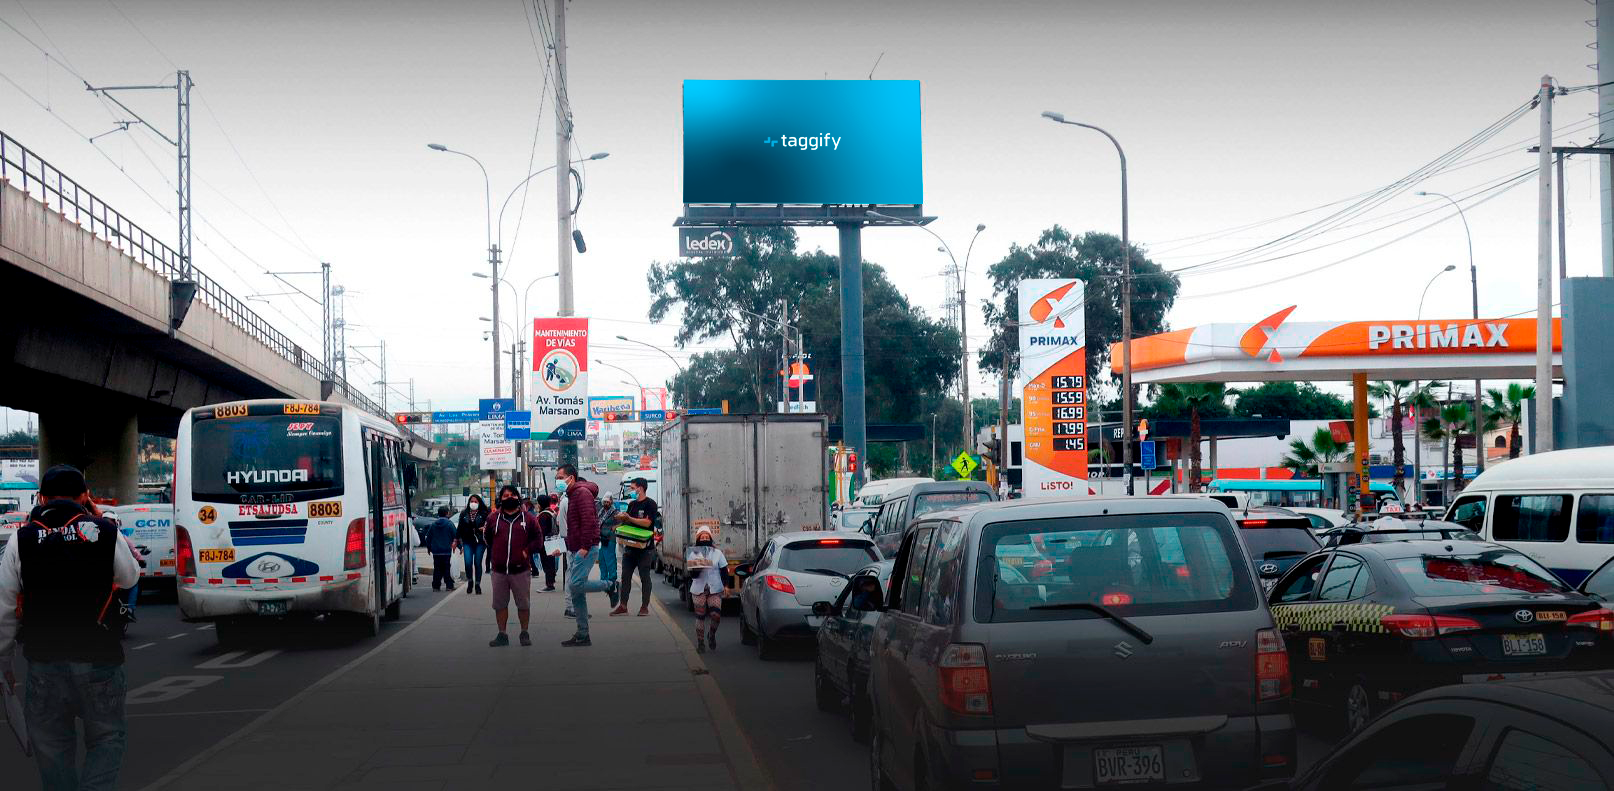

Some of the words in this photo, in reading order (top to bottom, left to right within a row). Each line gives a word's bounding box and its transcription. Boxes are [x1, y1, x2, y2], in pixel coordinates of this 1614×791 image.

[781, 133, 842, 151] taggify
[686, 235, 726, 251] ledex
[535, 329, 587, 337] MANTENIMIENTO
[1369, 325, 1508, 353] PRIMAX
[546, 338, 558, 347] DE
[558, 336, 576, 347] VÍAS
[1030, 335, 1079, 347] PRIMAX
[536, 396, 551, 405] Av.
[553, 395, 584, 405] Tomás
[217, 405, 246, 417] 8803
[284, 404, 319, 413] F8J-784
[539, 406, 580, 416] Marsano
[227, 469, 308, 484] HYUNDAI
[1041, 481, 1074, 493] LiSTO!
[200, 509, 215, 522] 34
[239, 504, 298, 516] ETSAJUDSA
[309, 503, 340, 517] 8803
[135, 519, 170, 527] GCM
[199, 550, 234, 561] F8J-784
[1219, 640, 1248, 649] APV
[1503, 638, 1544, 652] BLI-158
[1097, 754, 1161, 778] BVR-396
